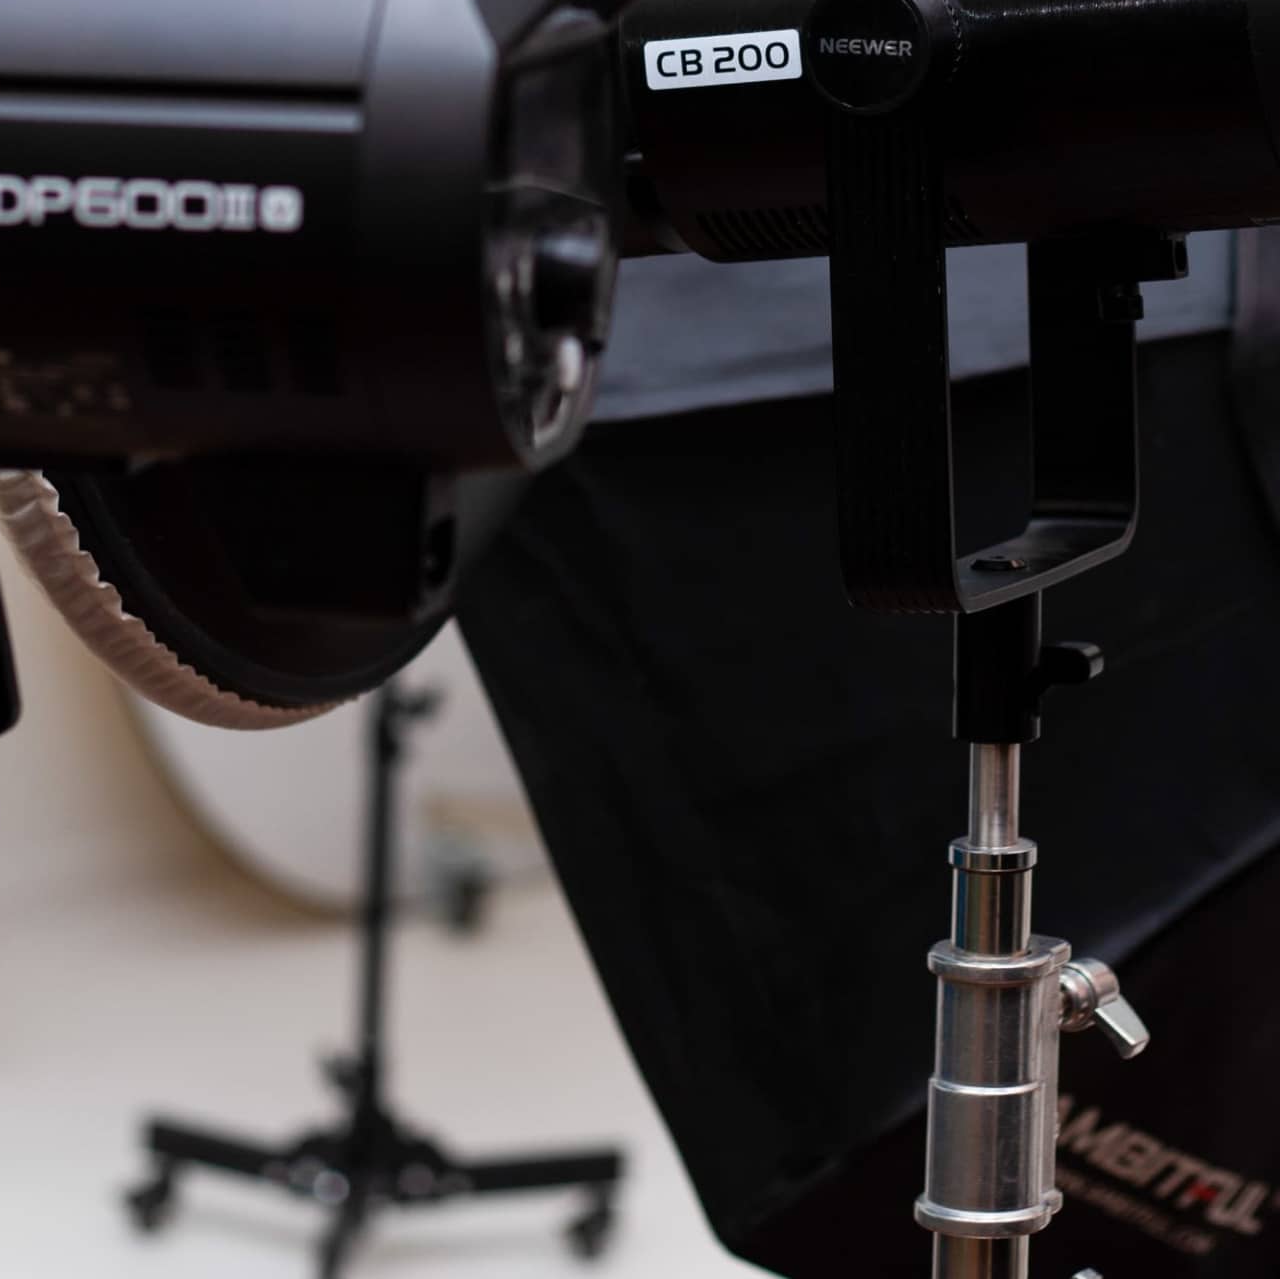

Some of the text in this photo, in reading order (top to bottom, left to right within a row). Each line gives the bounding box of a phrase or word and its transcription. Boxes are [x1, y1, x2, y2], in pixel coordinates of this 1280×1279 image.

[656, 42, 789, 78] CB 200
[820, 38, 912, 57] NEEWER
